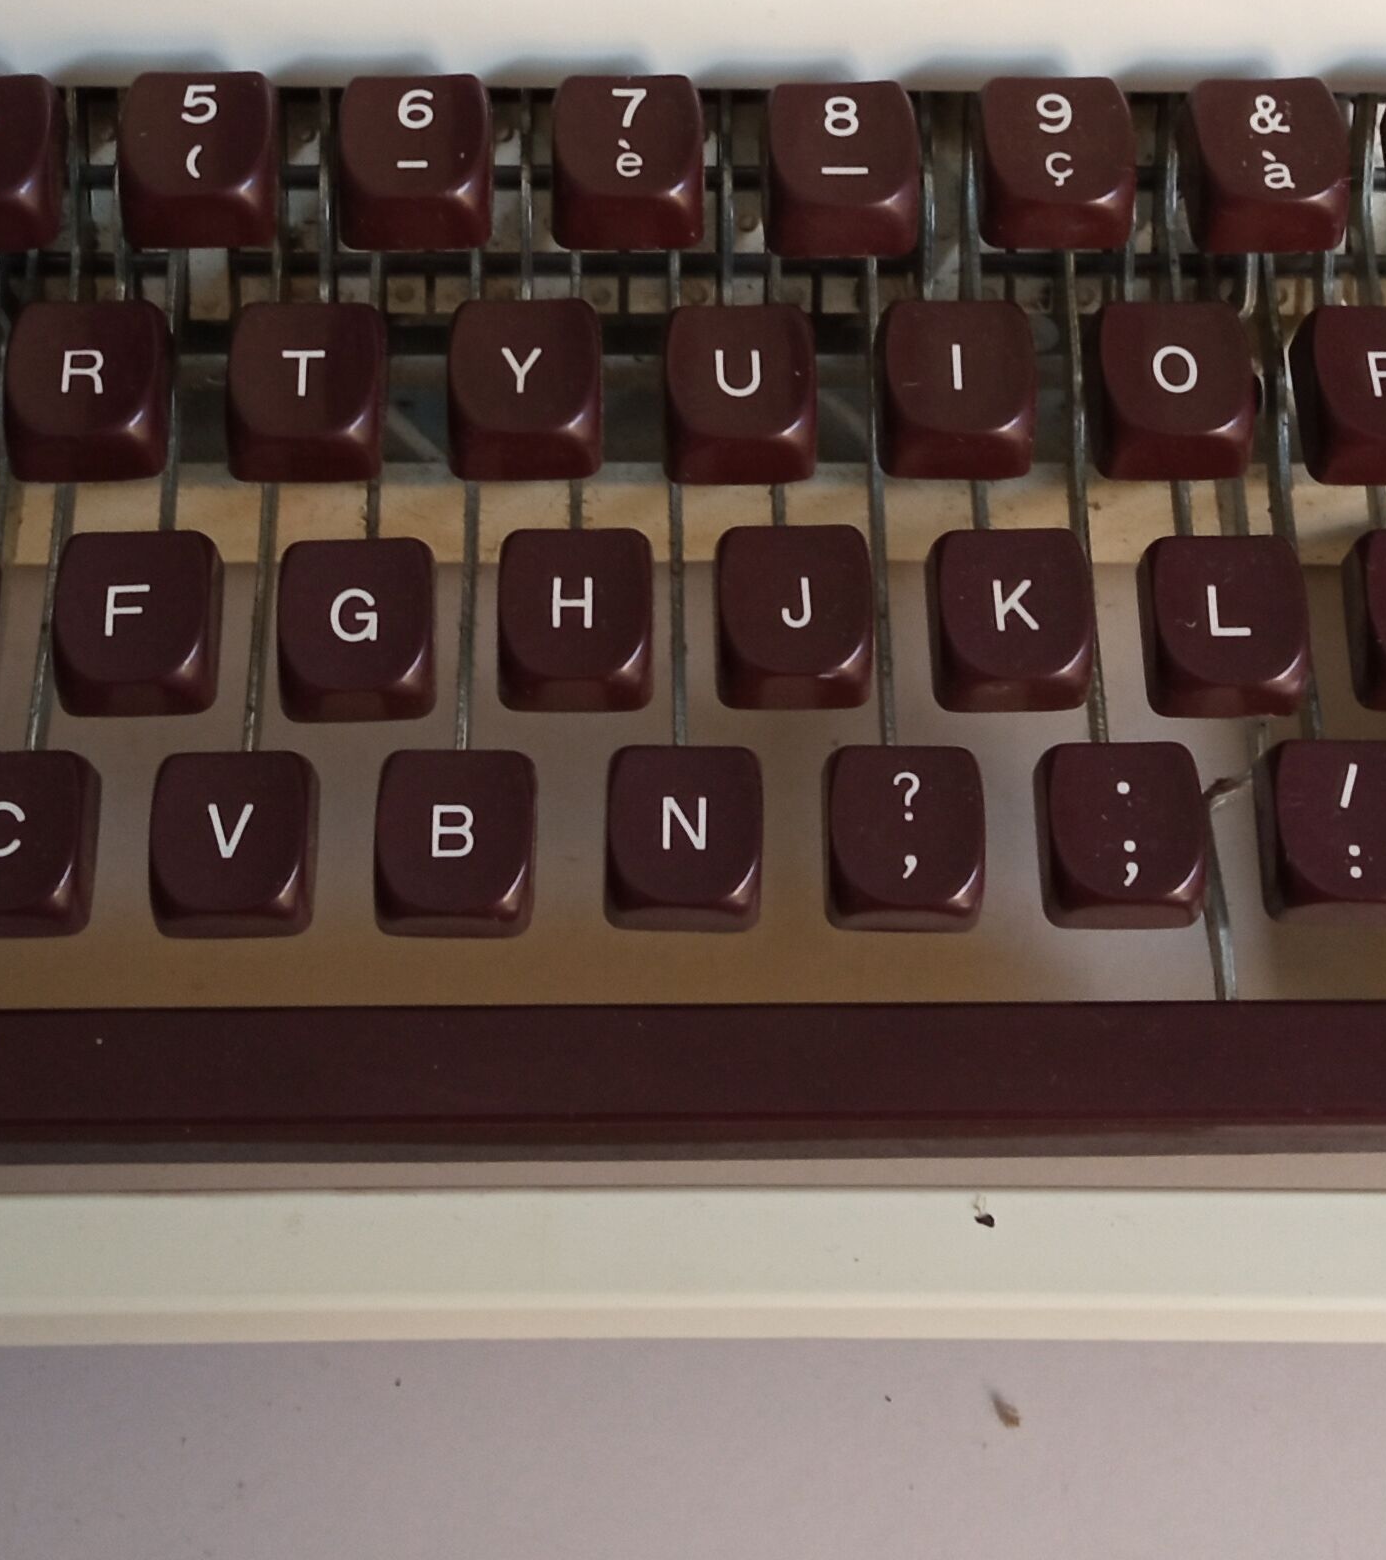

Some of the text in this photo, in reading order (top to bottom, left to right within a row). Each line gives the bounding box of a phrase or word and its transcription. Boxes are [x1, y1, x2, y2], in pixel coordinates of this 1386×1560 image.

[181, 84, 218, 124] 5
[397, 88, 434, 129] 6
[611, 88, 647, 128] 7
[824, 96, 859, 137] 8
[1035, 93, 1073, 134] 9
[1249, 94, 1291, 135] &
[616, 138, 643, 178] è
[1045, 151, 1074, 187] ç
[1261, 150, 1296, 190] à
[61, 349, 104, 394] R
[281, 349, 326, 397] T
[501, 347, 542, 394] Y
[714, 349, 761, 398] U
[1152, 345, 1198, 394] O
[104, 584, 151, 637] F
[330, 588, 378, 643] G
[552, 576, 593, 629] H
[781, 576, 812, 629] J
[992, 579, 1040, 632] K
[1206, 584, 1252, 637] L
[893, 771, 920, 822] ?
[1339, 763, 1358, 809] /
[207, 803, 254, 859] V
[431, 804, 474, 858] B
[662, 796, 707, 850] N
[1348, 844, 1363, 879] :
